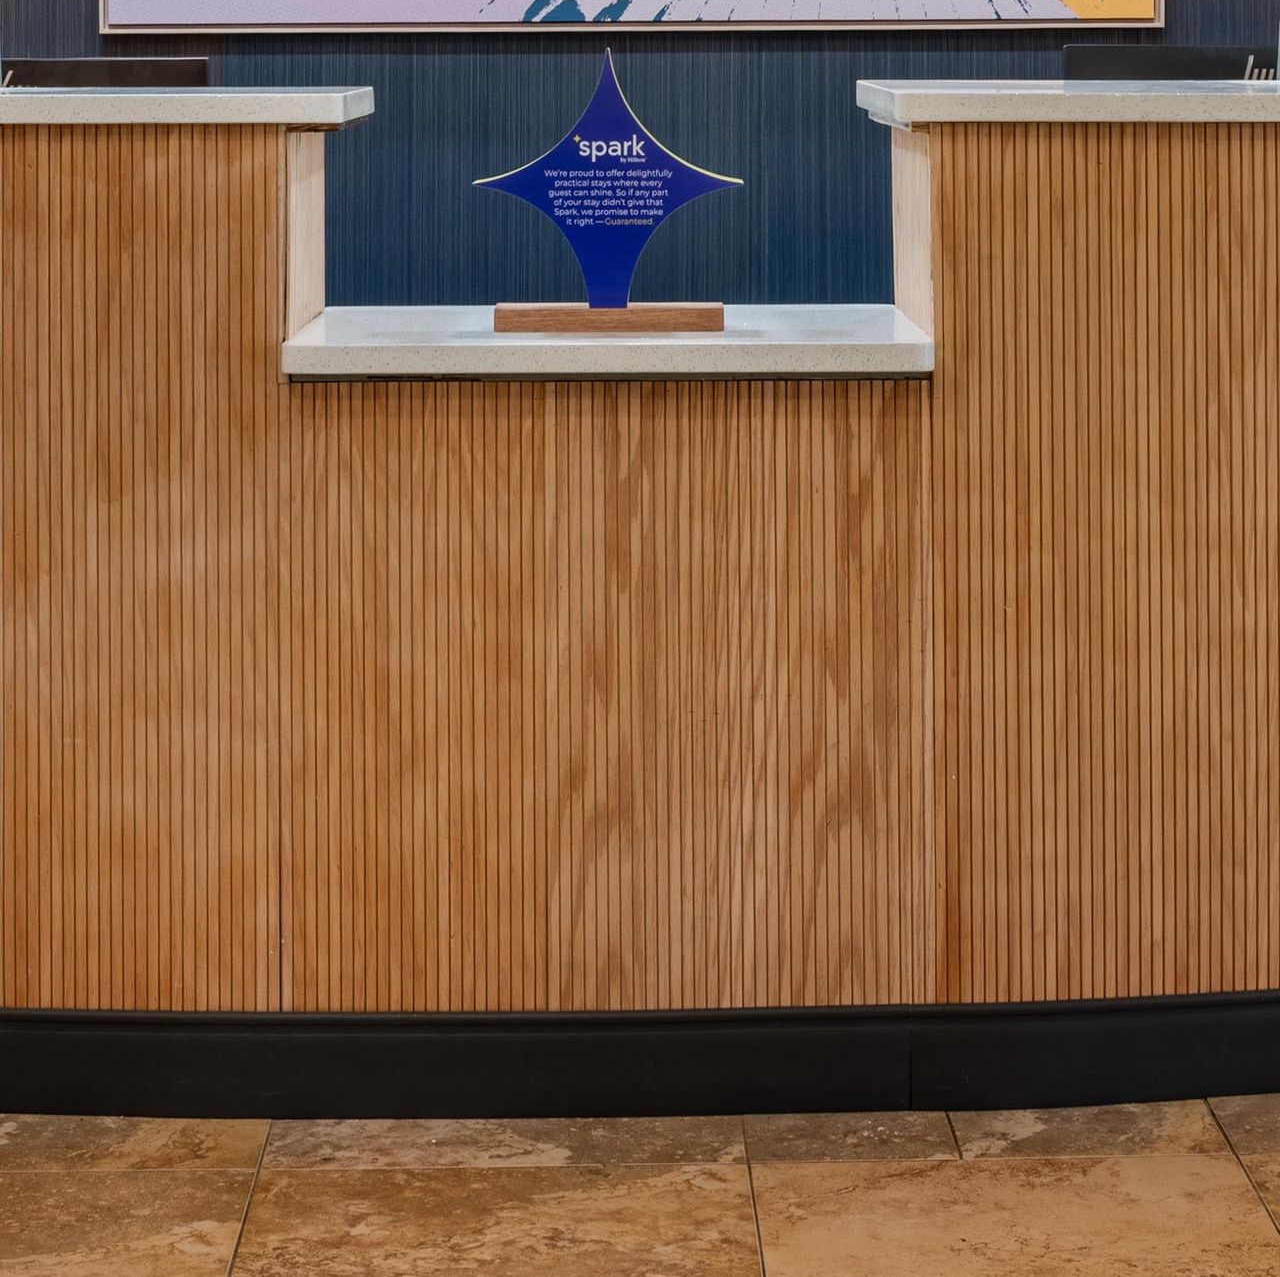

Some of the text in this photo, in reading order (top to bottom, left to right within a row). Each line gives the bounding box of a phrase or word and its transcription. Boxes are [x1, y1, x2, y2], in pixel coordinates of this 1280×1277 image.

[579, 134, 645, 162] spark
[569, 170, 594, 178] proud
[606, 169, 625, 177] offer
[626, 169, 672, 178] delightfully
[555, 179, 589, 188] practical
[591, 180, 612, 188] stays
[613, 179, 638, 187] where
[548, 189, 572, 198] guest
[636, 190, 650, 198] any
[652, 189, 668, 198] part
[554, 198, 562, 206] of
[583, 199, 600, 207] stay
[627, 199, 645, 207] give
[646, 198, 663, 206] that
[595, 209, 628, 217] promise
[574, 218, 594, 226] right
